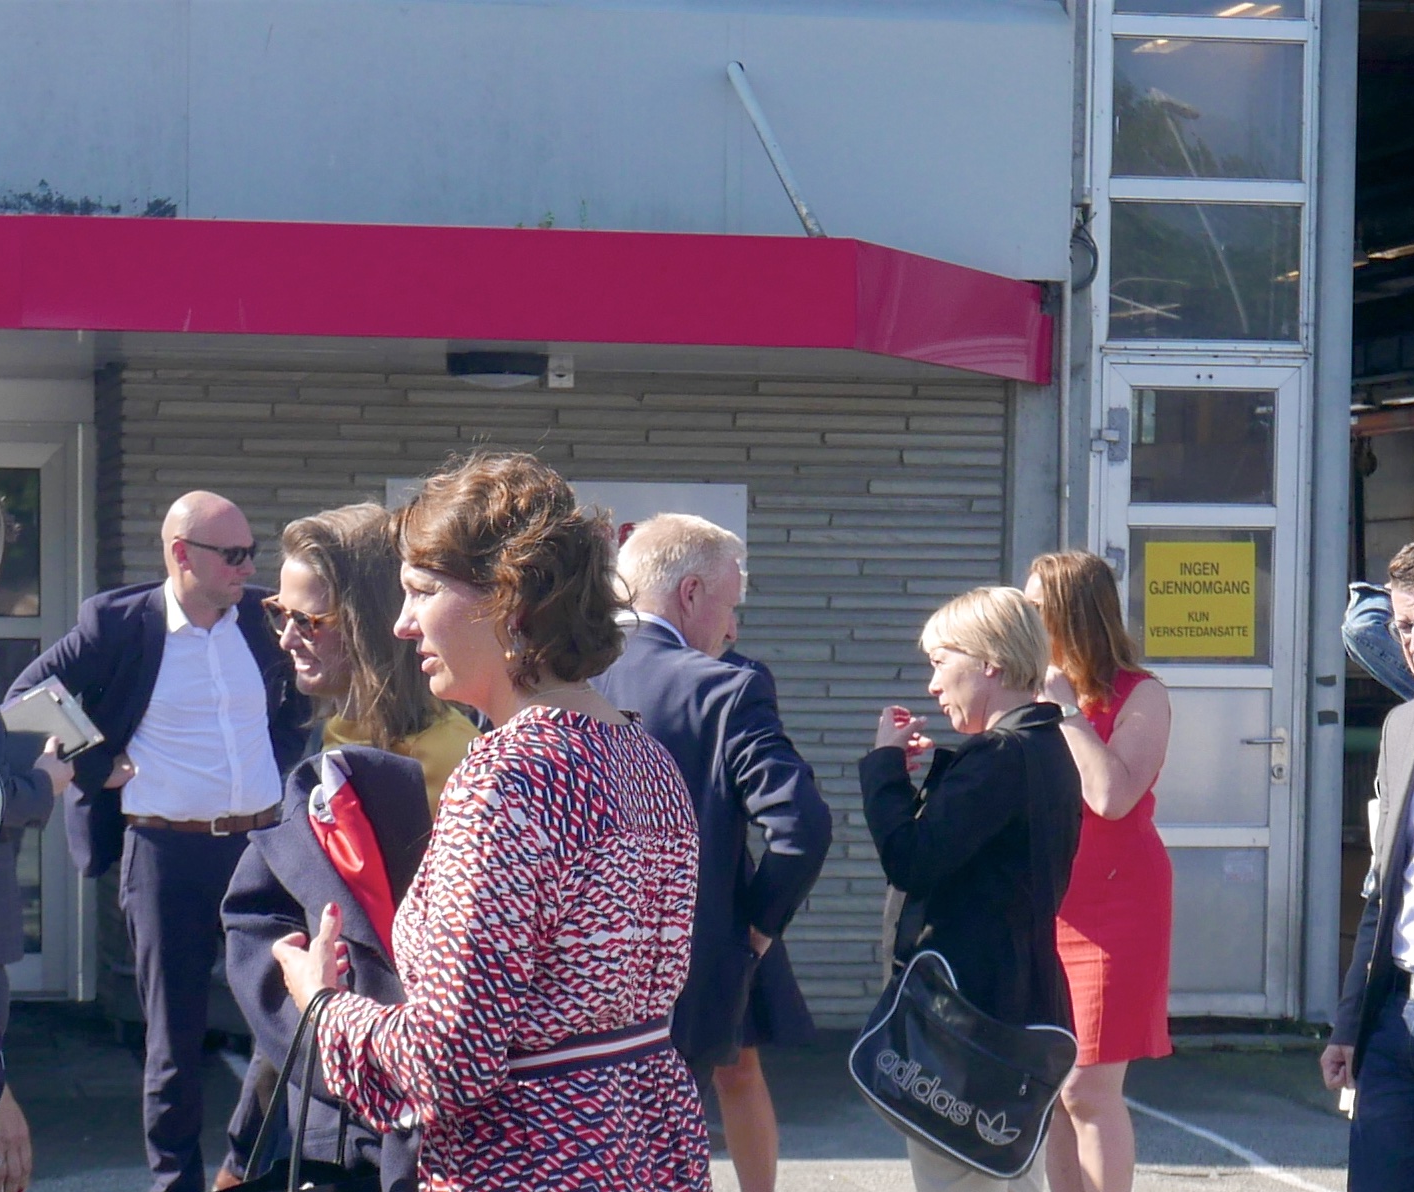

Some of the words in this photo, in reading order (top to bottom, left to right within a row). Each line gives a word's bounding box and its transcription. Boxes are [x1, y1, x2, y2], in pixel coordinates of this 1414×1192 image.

[1180, 562, 1219, 576] INGEN
[1149, 581, 1250, 595] GJENNOMGANG
[1187, 611, 1209, 622] KUN
[1149, 625, 1248, 638] VERKSTEDANSATTE
[876, 1049, 973, 1126] adidas
